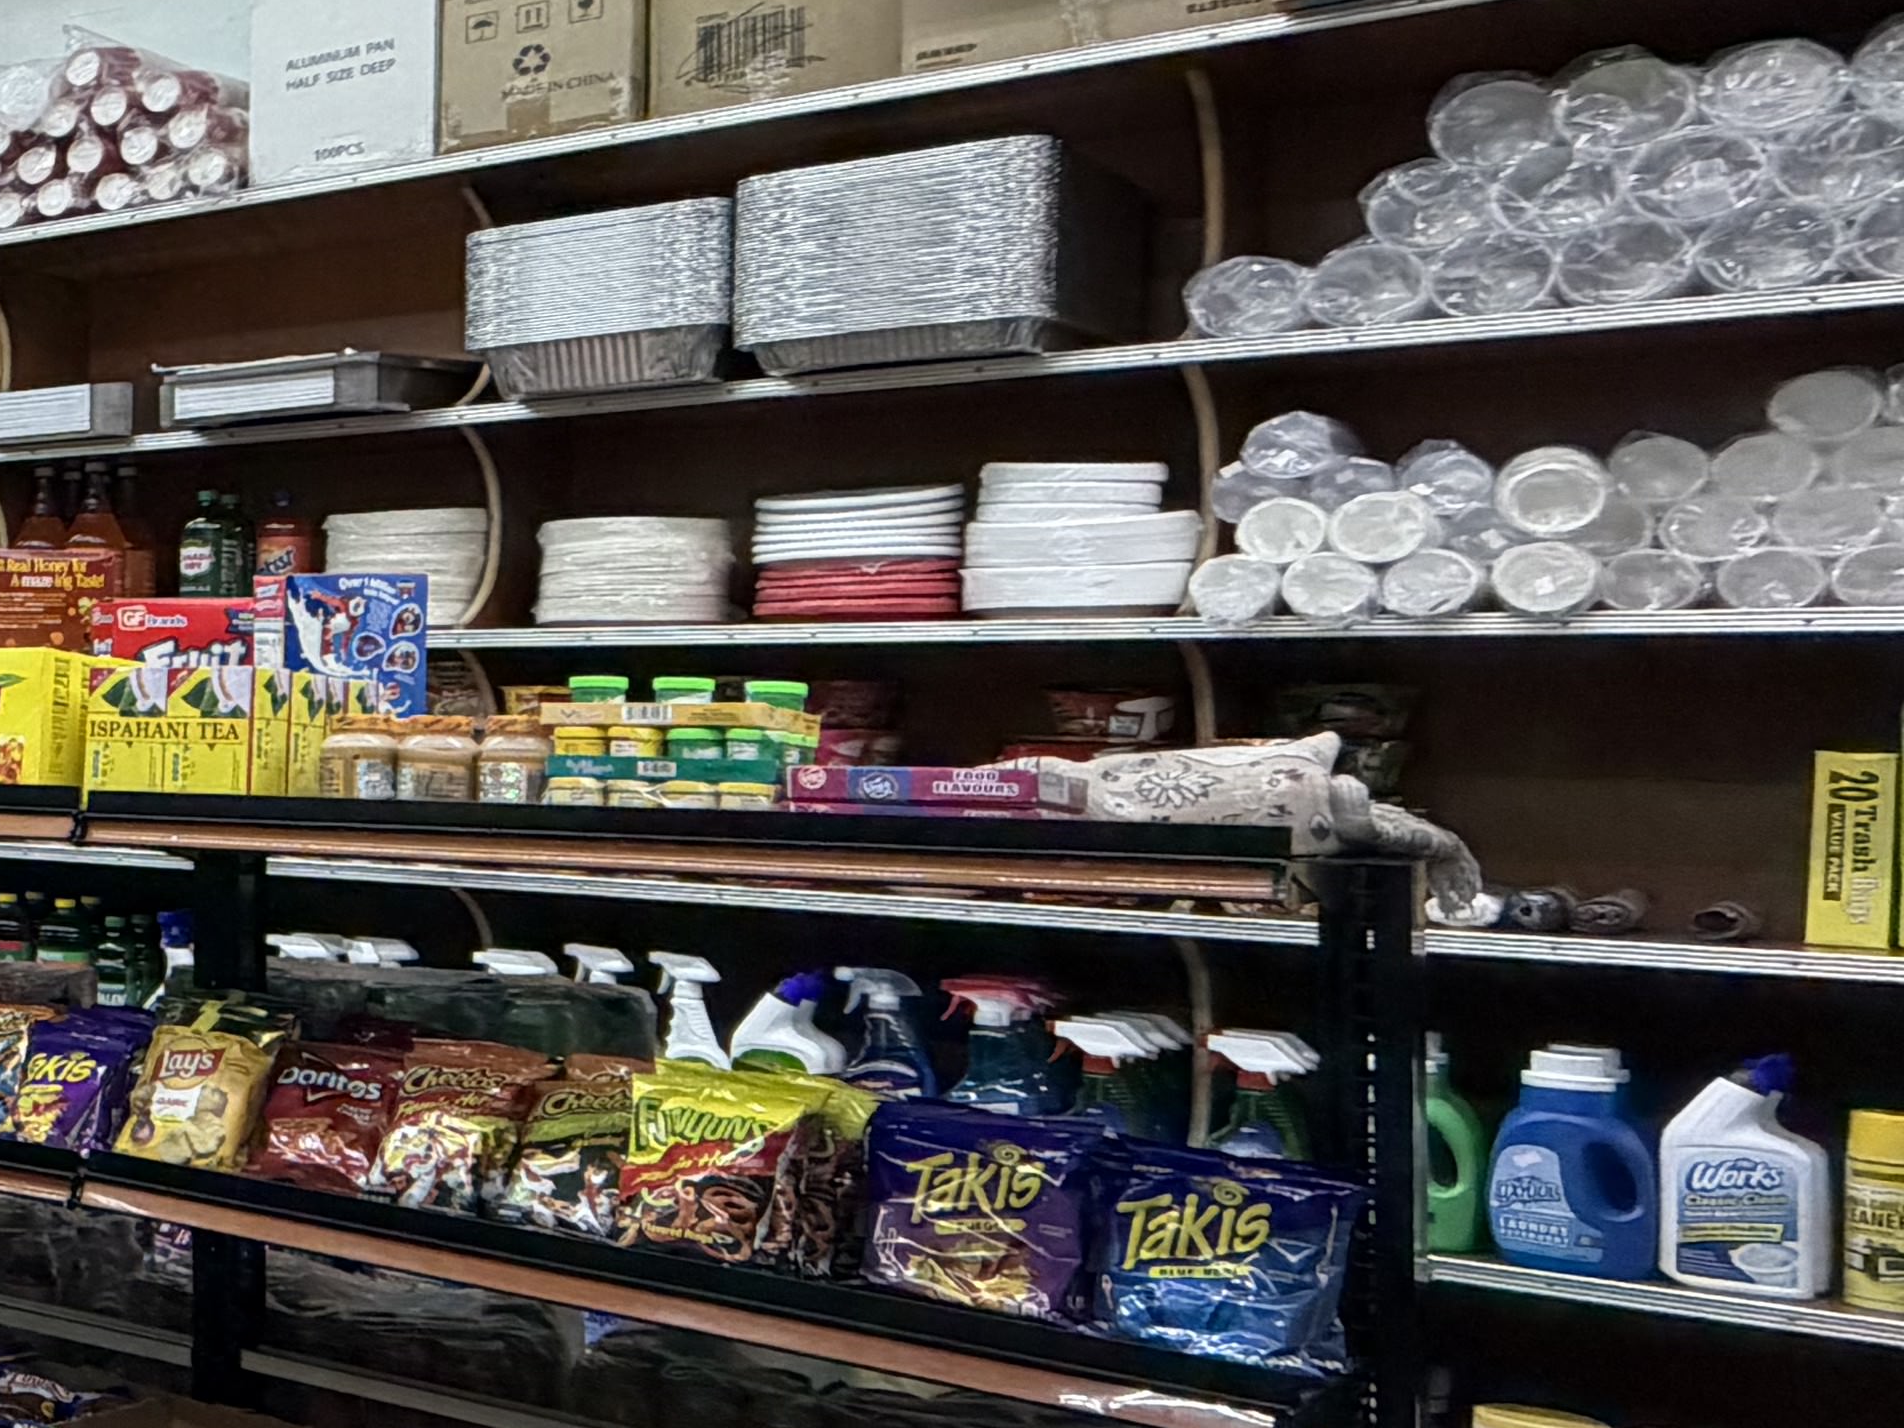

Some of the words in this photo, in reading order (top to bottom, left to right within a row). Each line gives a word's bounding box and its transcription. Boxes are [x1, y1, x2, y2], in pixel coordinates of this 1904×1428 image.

[366, 38, 396, 54] PAN
[285, 73, 320, 91] HALF
[326, 67, 354, 85] SIZE
[360, 58, 397, 77] DEEP
[500, 82, 541, 101] MADE
[567, 71, 616, 91] CHINA
[314, 142, 366, 162] 100PCS
[6, 559, 31, 574] Real
[34, 559, 68, 576] Honey
[122, 609, 142, 627] GF
[145, 612, 188, 629] Brands
[89, 719, 188, 741] ISPAHANI
[198, 721, 240, 741] TEA
[932, 781, 1020, 798] FLAVOURS
[953, 768, 999, 783] FOOD
[1828, 769, 1880, 802] 20
[1828, 811, 1844, 853] VALUE
[1851, 805, 1878, 874] Trash
[1826, 856, 1842, 893] PACK
[157, 1048, 214, 1078] Lay's
[277, 1066, 382, 1100] Doritos
[401, 1066, 507, 1096] Cheetos
[542, 1089, 632, 1120] Cheeto
[906, 1144, 1045, 1224] Takis
[1690, 1160, 1785, 1191] Works
[1116, 1180, 1273, 1270] Takis
